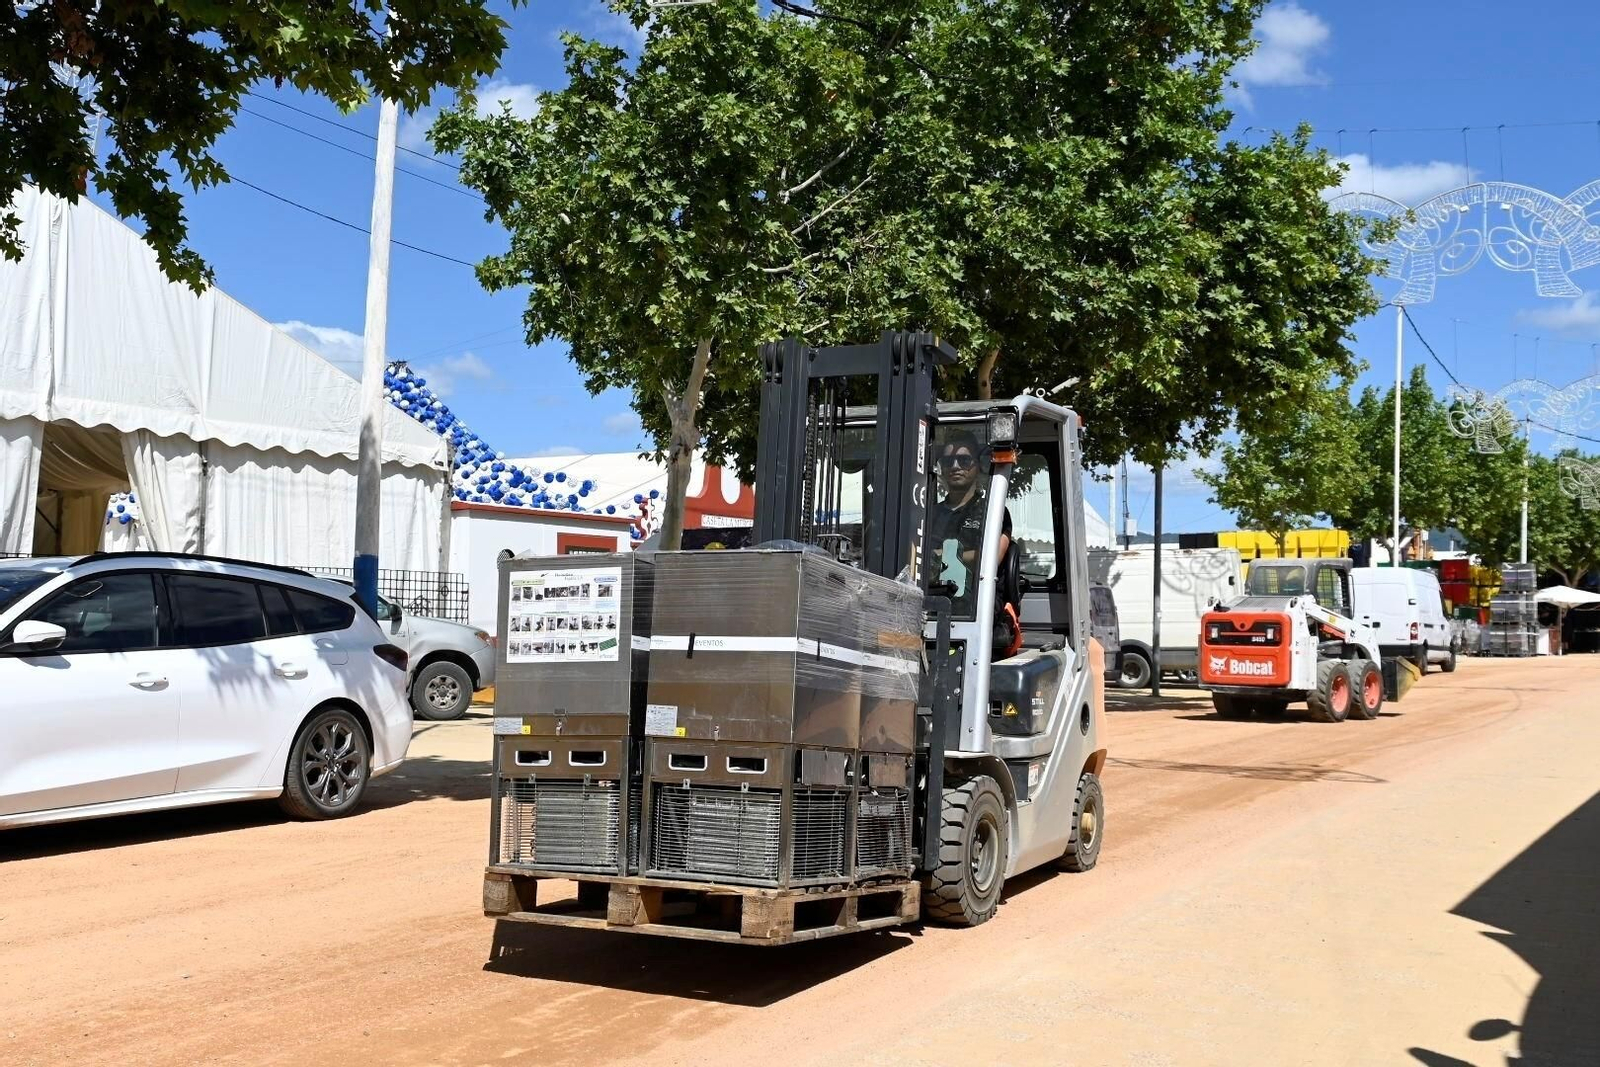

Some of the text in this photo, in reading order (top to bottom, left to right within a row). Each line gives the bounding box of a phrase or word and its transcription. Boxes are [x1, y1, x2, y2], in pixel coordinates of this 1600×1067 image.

[702, 514, 725, 527] CASETA
[914, 518, 925, 587] TILL
[695, 639, 724, 647] EVENTOS
[1229, 658, 1273, 676] Bobcat
